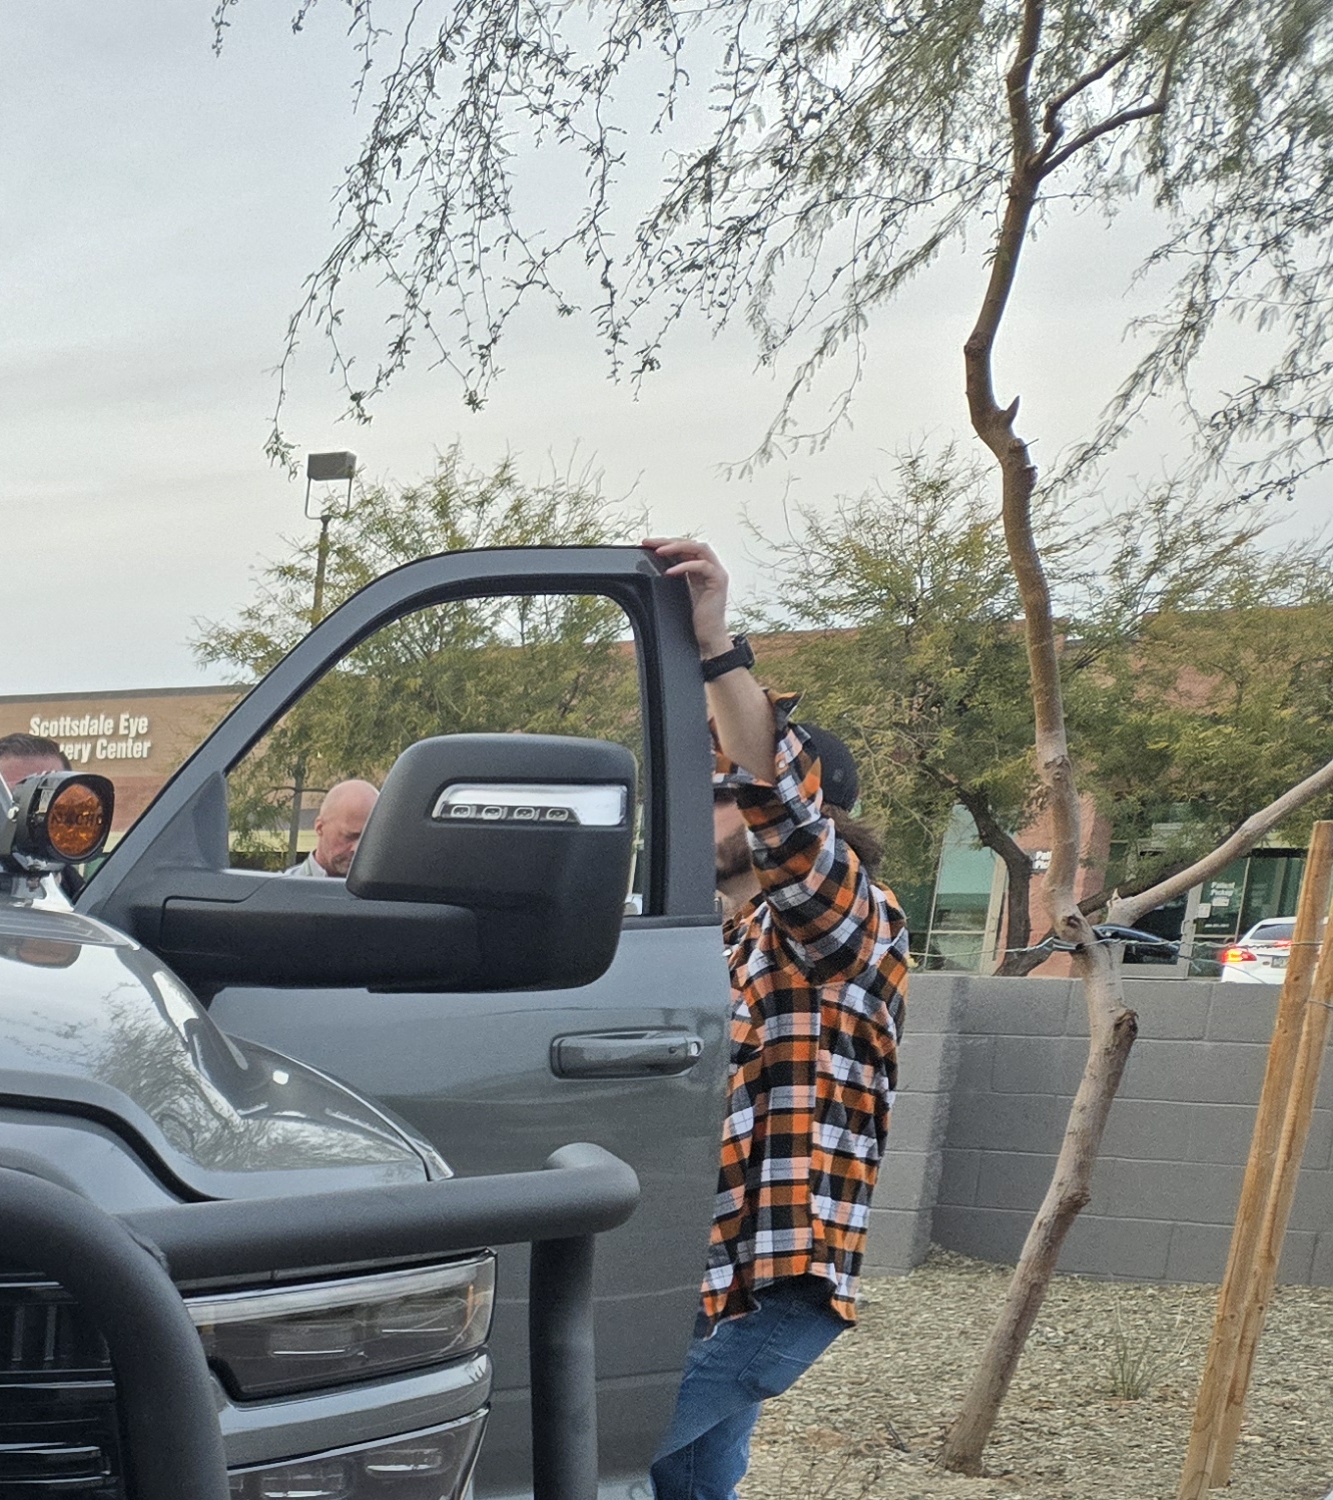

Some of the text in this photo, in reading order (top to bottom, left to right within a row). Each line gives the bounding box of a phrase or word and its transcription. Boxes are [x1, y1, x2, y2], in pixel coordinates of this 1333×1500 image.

[29, 713, 149, 738] Scottsdale Eye
[96, 738, 151, 760] Center
